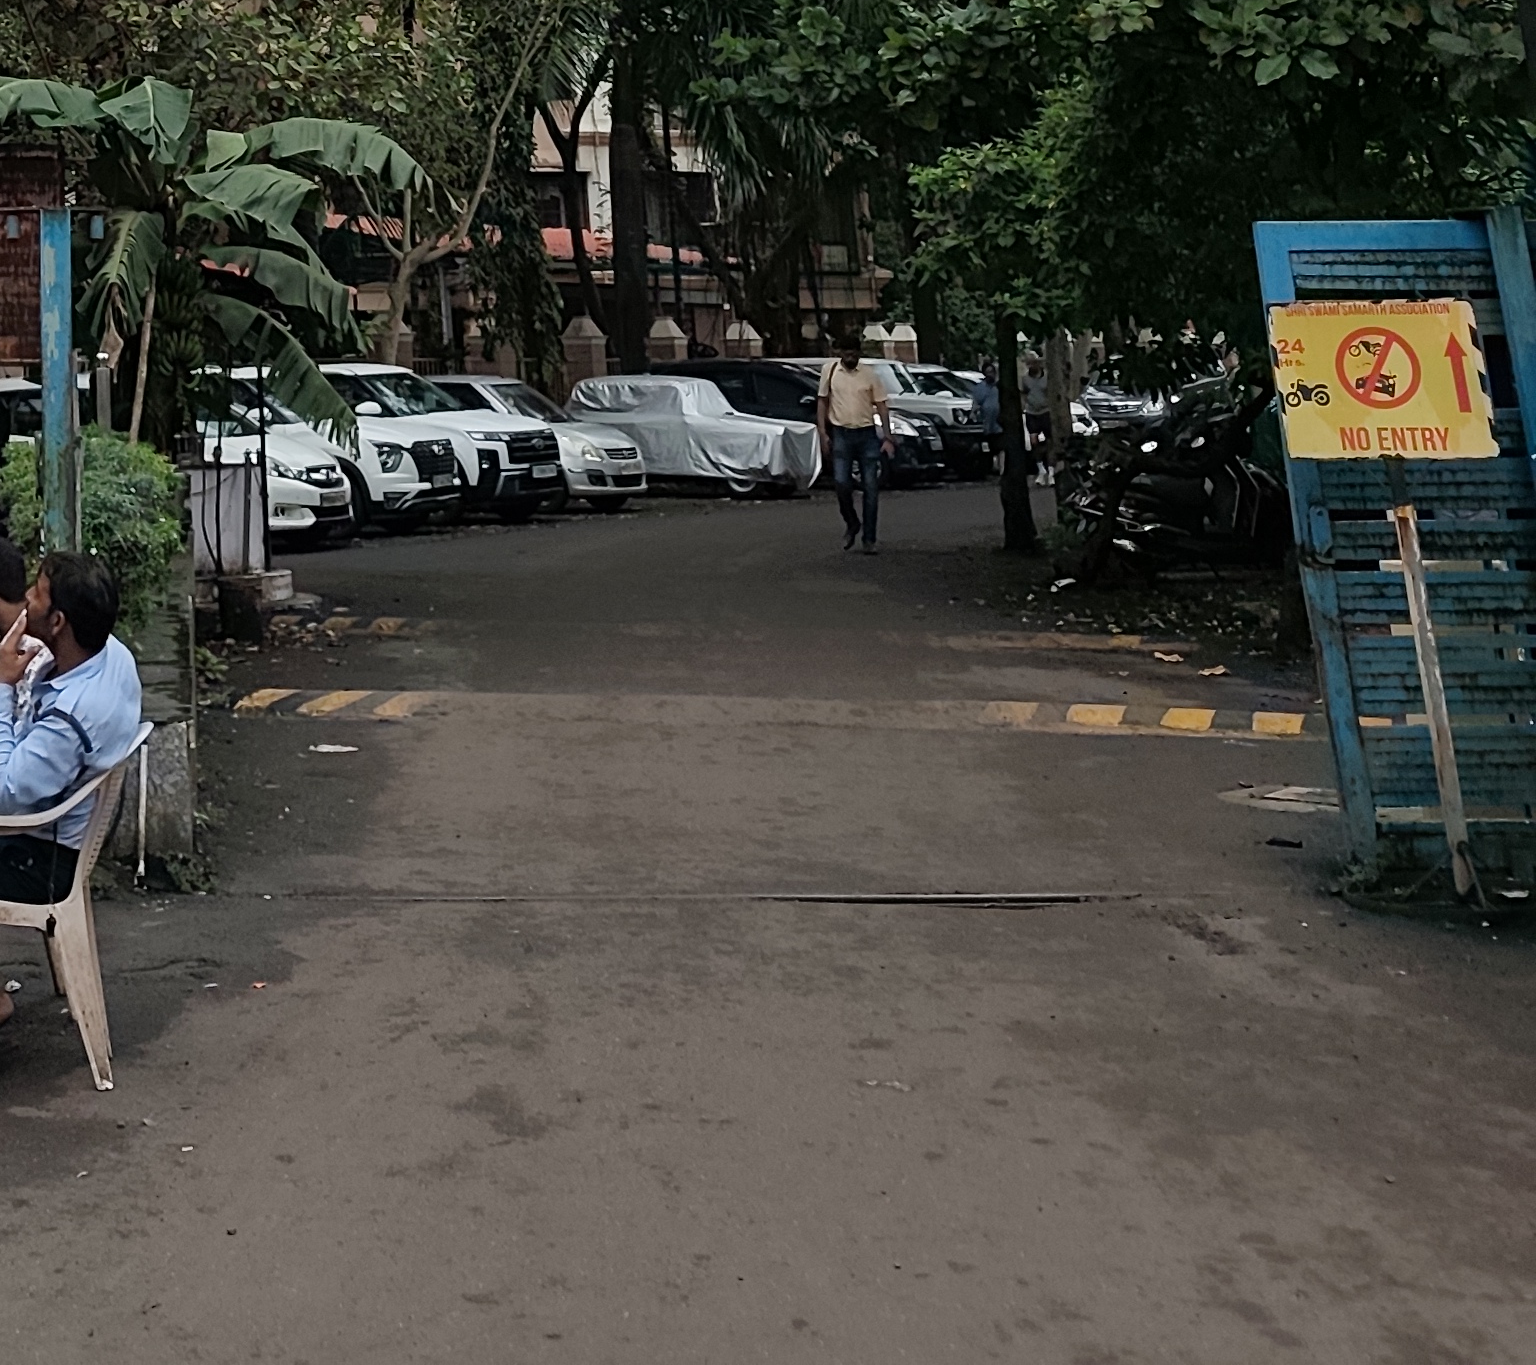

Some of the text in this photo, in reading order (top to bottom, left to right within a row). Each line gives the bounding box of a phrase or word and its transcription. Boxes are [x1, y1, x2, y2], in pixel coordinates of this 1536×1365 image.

[1307, 303, 1339, 317] SWAMI
[1342, 302, 1387, 316] SAMARTH
[1389, 302, 1450, 315] ASSOCIATION
[1276, 338, 1305, 355] 24
[1339, 427, 1449, 452] NO ENTRY
